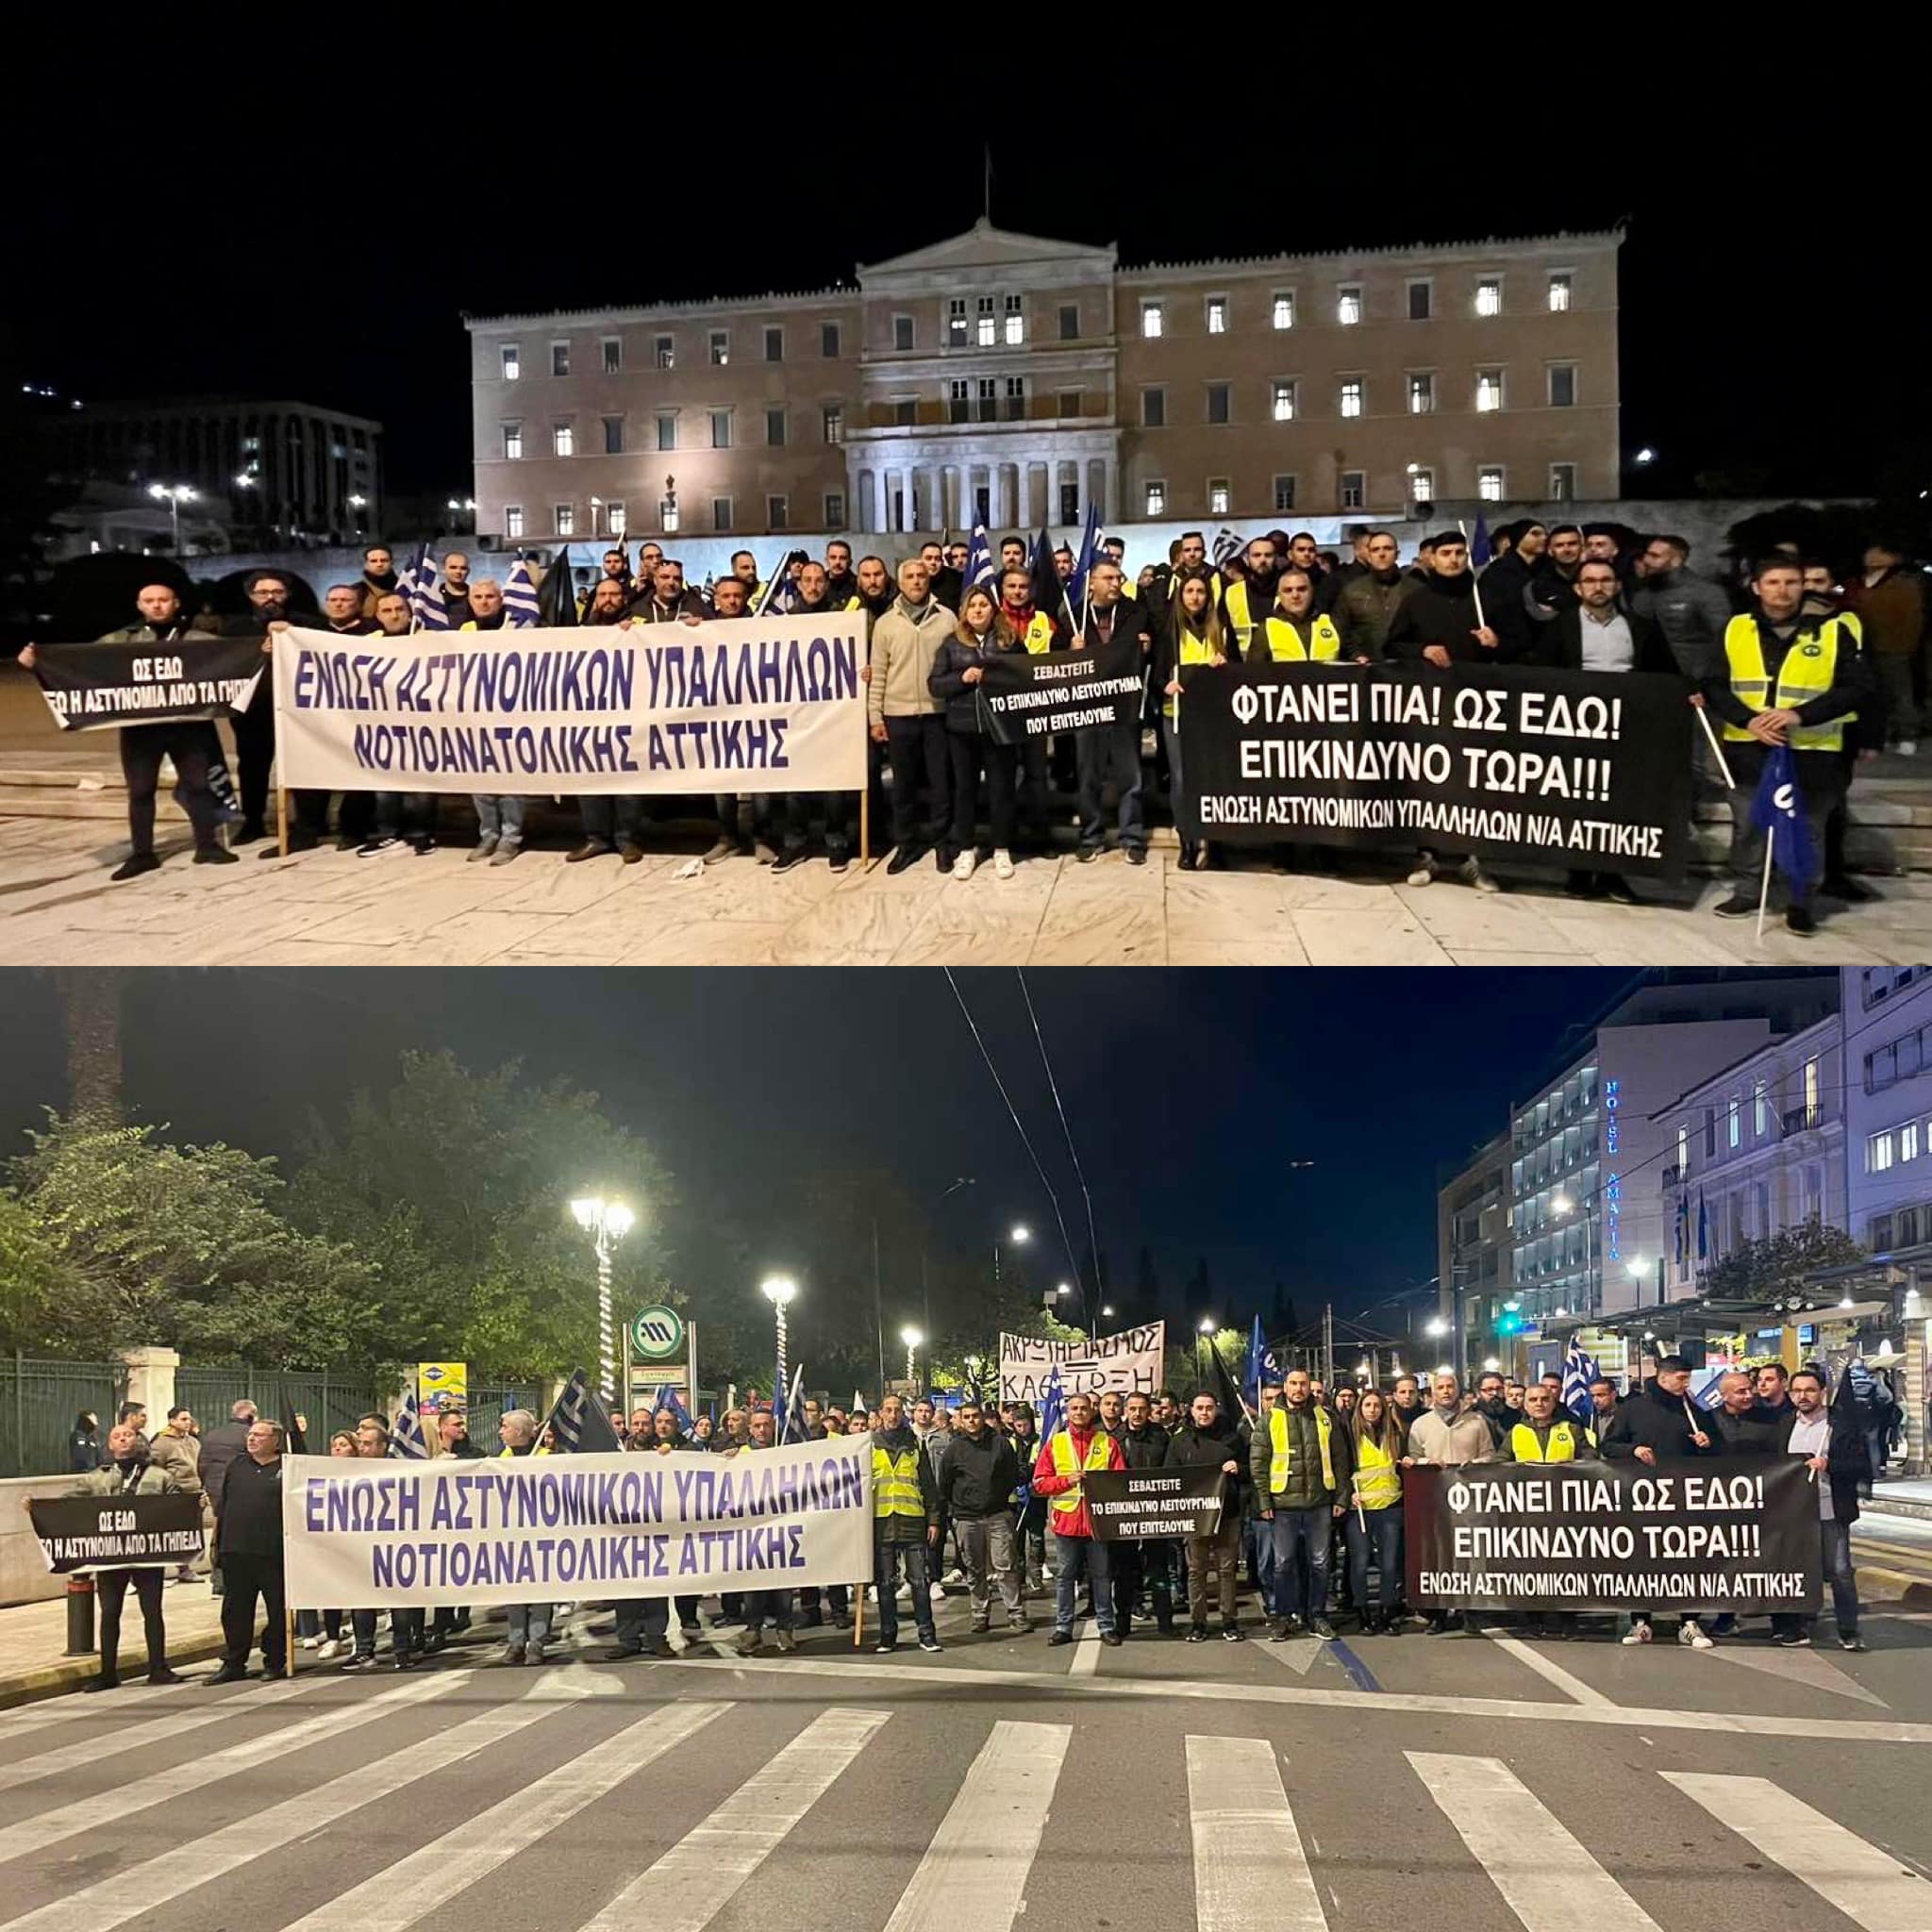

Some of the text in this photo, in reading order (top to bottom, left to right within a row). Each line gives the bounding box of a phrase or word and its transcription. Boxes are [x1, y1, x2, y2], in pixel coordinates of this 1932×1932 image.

[132, 657, 183, 681] ΩΣ ΕΔΩ
[293, 635, 858, 713] ΕΝΩΣΗ ΑΣΤΥΝΟΜΙΚΩΝ ΥΠΑΛΛΗΛΩΝ
[1033, 659, 1094, 680] ΣΕΒΑΣΤΕΙΤΕ
[70, 690, 82, 714] Η
[86, 685, 166, 713] ΑΣΤΥΝΟΜΙΑ
[168, 683, 196, 707] ΑΠΟ
[198, 681, 217, 704] ΤΑ
[990, 675, 1142, 713] ΤΟ ΕΠΙΚΙΝΔΥΝΟ ΛΕΙΤΟΥΡΓΗΜΑ
[1025, 706, 1115, 734] ΠΟΥ ΕΠΙΤΕΛΟΥΜΕ
[1232, 684, 1622, 741] ΦΤΑΝΕΙ ΠΙΑ! ΩΣ ΕΔΩ!
[355, 718, 791, 774] ΝΟΤΙΟΑΝΑΤΟΛΙΚΗΣ ΑΤΤΙΚΗΣ
[1240, 740, 1611, 801] ΕΠΙΚΙΝΔΥΝΟ ΤΩΡΑ!!!
[1200, 796, 1663, 858] ΕΝΩΣΗ ΑΣΤΥΝΟΜΙΚΩΝ ΥΠΑΛΛΗΛΩΝ Ν/Α ΑΤΤΙΚΗΣ
[306, 1456, 862, 1533] ΕΝΩΣΗ ΑΣΤΥΝΟΜΙΚΩΝ ΥΠΑΛΛΗΛΩΝ
[1129, 1478, 1181, 1492] ΣΕΒΑΣΤΕΙΤΕ
[1447, 1475, 1765, 1513] ΦΤΑΝΕΙ ΠΙΑ! ΩΣ ΕΔΩ!
[99, 1510, 136, 1532] ΩΣ ΕΔΩ
[1091, 1496, 1221, 1515] ΤΟ ΕΠΙΚΙΝΔΥΝΟ ΛΕΙΤΟΥΡΓΗΜΑ
[55, 1538, 63, 1558] Η
[65, 1536, 123, 1558] ΑΣΤΥΝΟΜΙΑ
[125, 1534, 145, 1555] ΑΠΟ
[147, 1533, 161, 1553] ΤΑ
[162, 1530, 202, 1552] ΓΗΠΕΔΑ
[1119, 1519, 1195, 1536] ΠΟΥ ΕΠΙΤΕΛΟΥΜΕ
[1454, 1524, 1760, 1559] ΕΠΙΚΙΝΔΥΝΟ ΤΩΡΑ!!!
[372, 1524, 806, 1589] ΝΟΤΙΟΑΝΑΤΟΛΙΚΗΣ ΑΤΤΙΚΗΣ
[1420, 1572, 1805, 1597] ΕΝΩΣΗ ΑΣΤΥΝΟΜΙΚΩΝ ΥΠΑΛΛΗΛΩΝ Ν/Α ΑΤΤΙΚΗΣ
